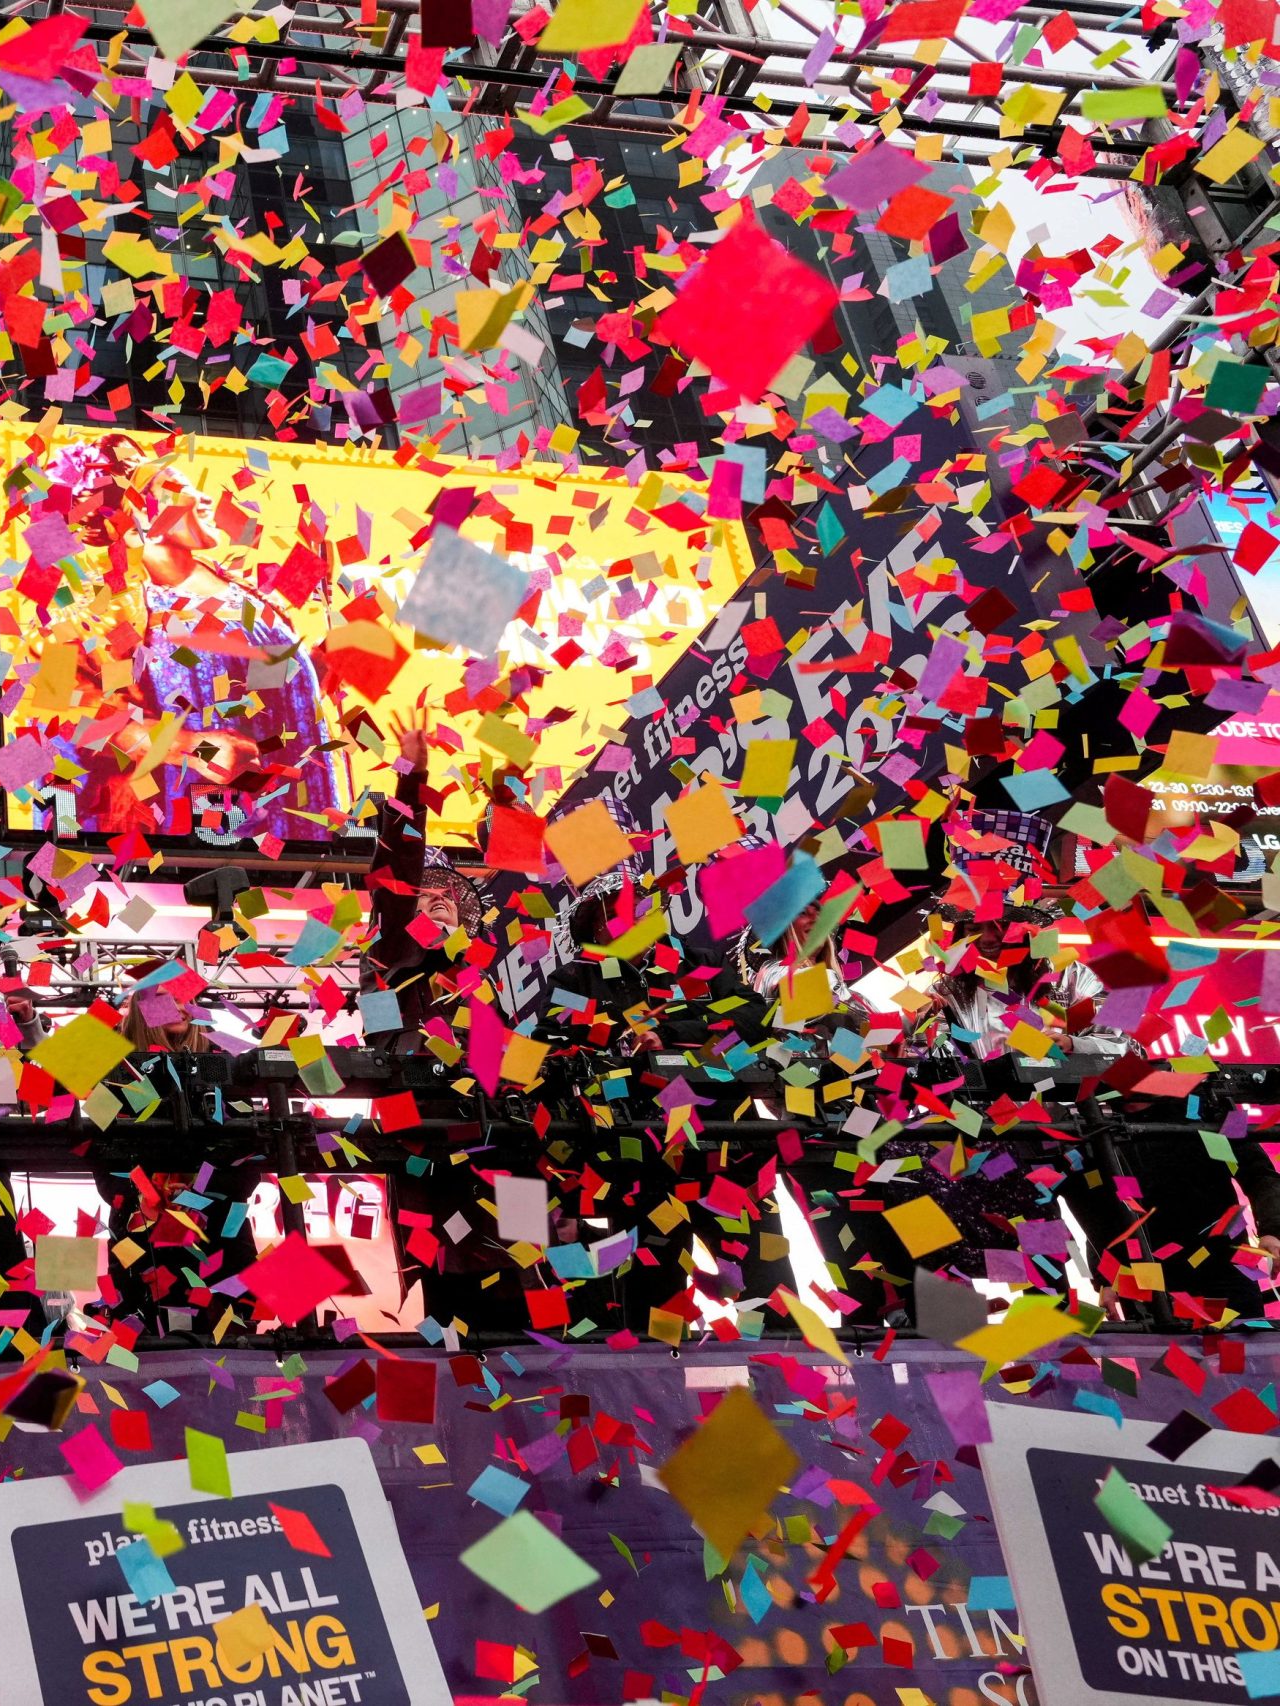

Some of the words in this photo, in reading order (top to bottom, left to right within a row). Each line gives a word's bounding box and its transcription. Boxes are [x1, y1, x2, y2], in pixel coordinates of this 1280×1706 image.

[1252, 833, 1280, 850] LG
[244, 1566, 339, 1615] ALL
[82, 1614, 357, 1706] STRONG
[1116, 1645, 1169, 1679] ON
[1167, 1650, 1247, 1687] THIS
